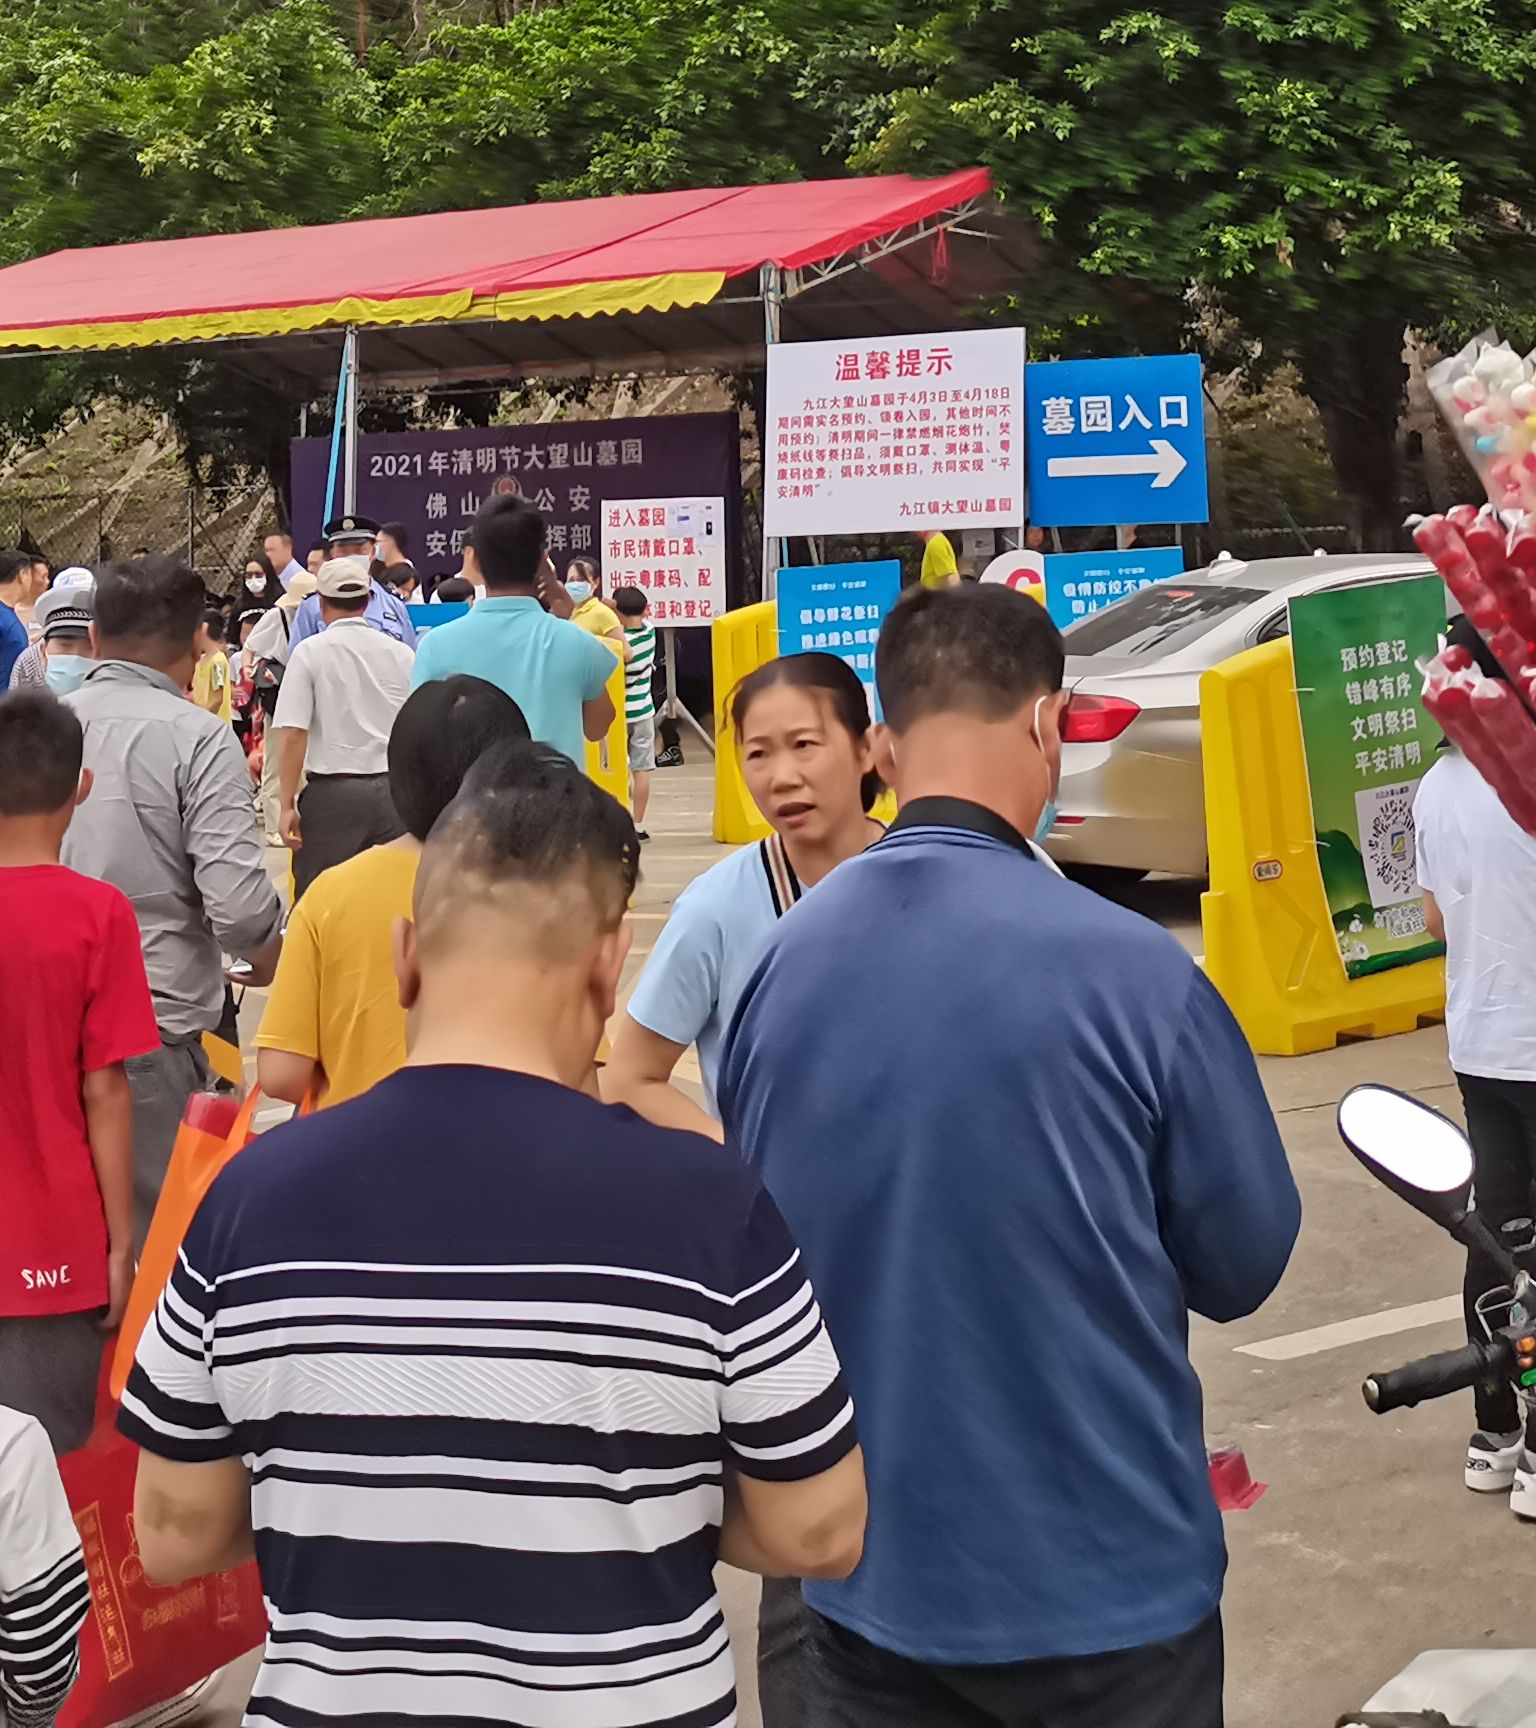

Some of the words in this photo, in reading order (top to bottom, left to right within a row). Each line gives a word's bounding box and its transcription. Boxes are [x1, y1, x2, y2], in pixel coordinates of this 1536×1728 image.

[835, 347, 953, 381] 温馨提示
[1041, 394, 1188, 435] 墓园入口
[370, 438, 643, 478] 2021年清明节大望山墓园
[609, 508, 665, 527] 进入墓园
[900, 498, 1012, 516] 九江镇大望山墓园
[1340, 639, 1409, 673] 预约登记
[1345, 672, 1412, 706] 错峰有序
[1350, 707, 1418, 743] 文明祭扫
[1355, 741, 1422, 776] 平安清明
